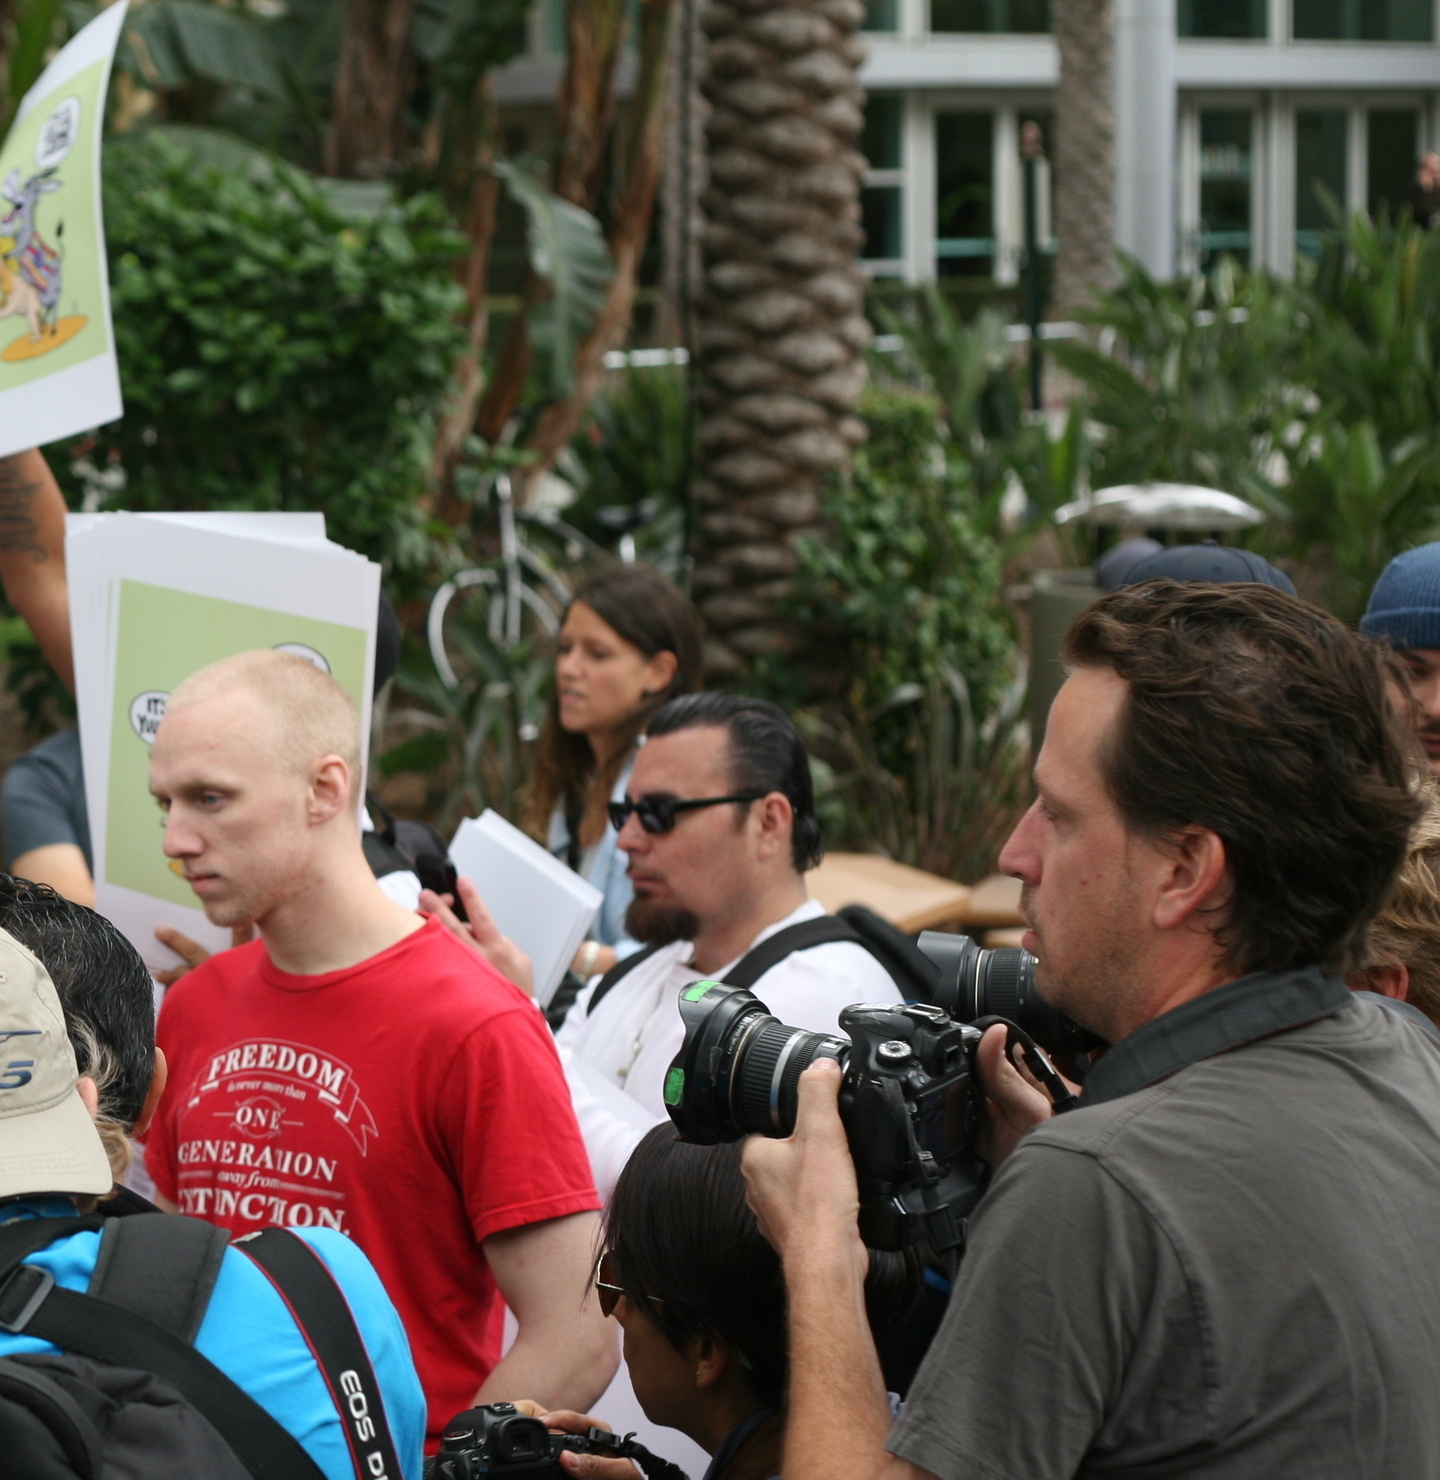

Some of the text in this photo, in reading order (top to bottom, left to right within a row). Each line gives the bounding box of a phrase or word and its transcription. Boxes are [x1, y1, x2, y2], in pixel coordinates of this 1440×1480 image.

[208, 1043, 346, 1095] FREEDOM
[235, 1081, 263, 1091] never
[284, 1083, 307, 1101] than
[235, 1105, 282, 1131] ONE
[177, 1139, 338, 1182] GENERATION
[217, 1170, 281, 1190] away from
[340, 1369, 390, 1480] EOS D
